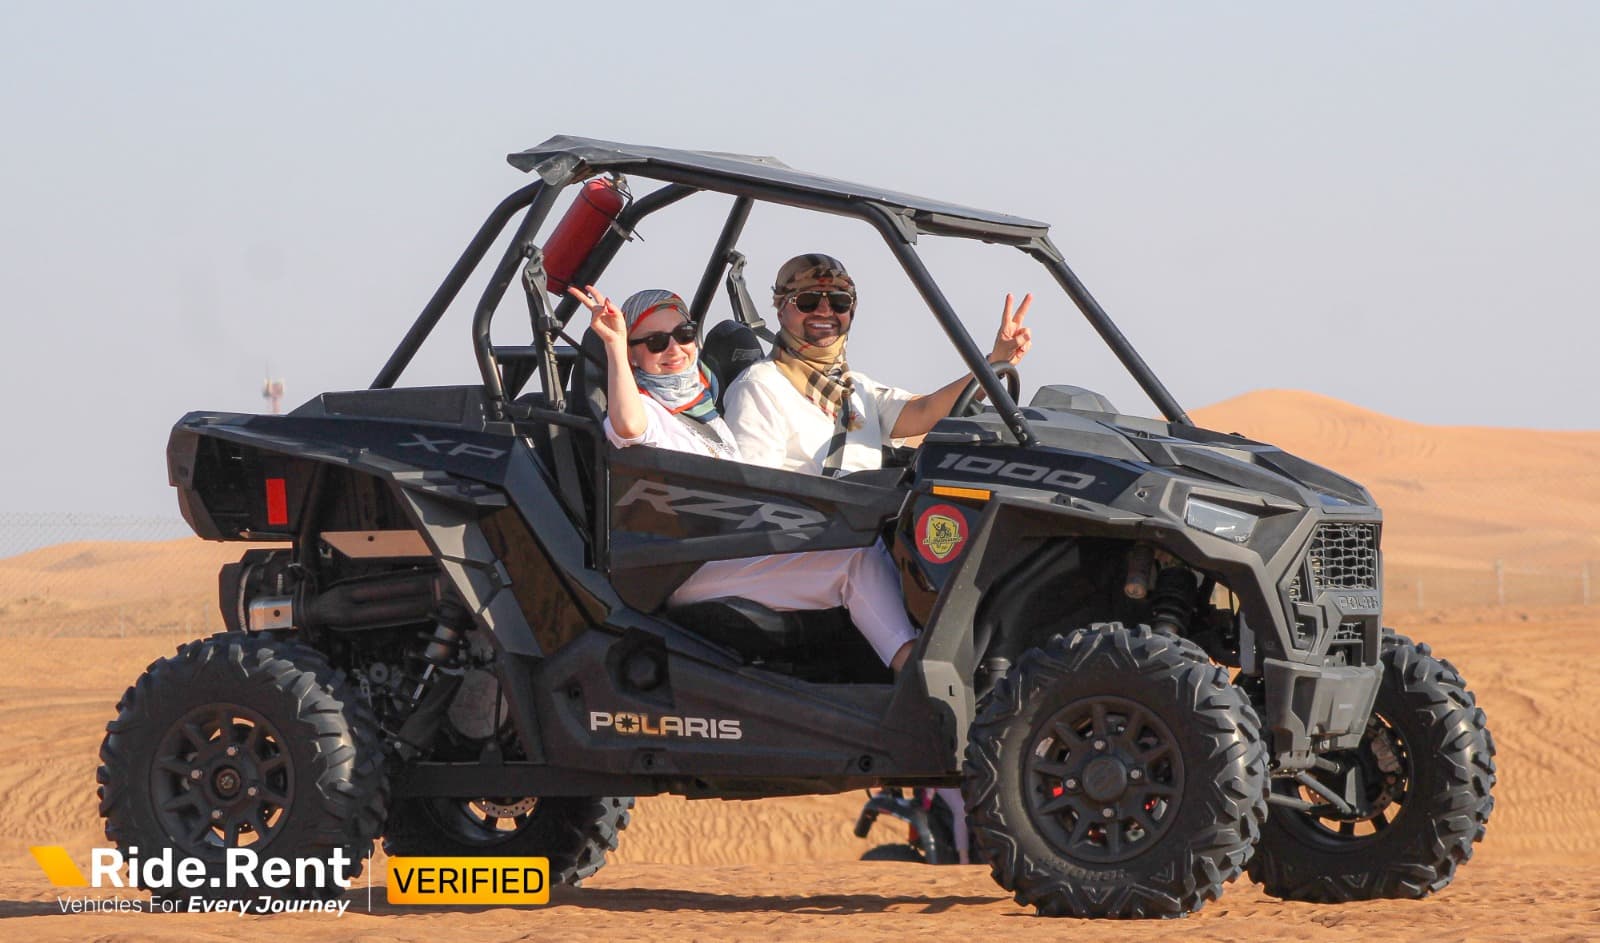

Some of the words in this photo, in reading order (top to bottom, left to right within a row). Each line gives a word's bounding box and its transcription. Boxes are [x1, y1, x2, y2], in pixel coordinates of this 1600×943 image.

[397, 433, 506, 459] XP
[937, 453, 1096, 490] 1000
[615, 479, 828, 540] RZR
[590, 711, 742, 740] POLARIS
